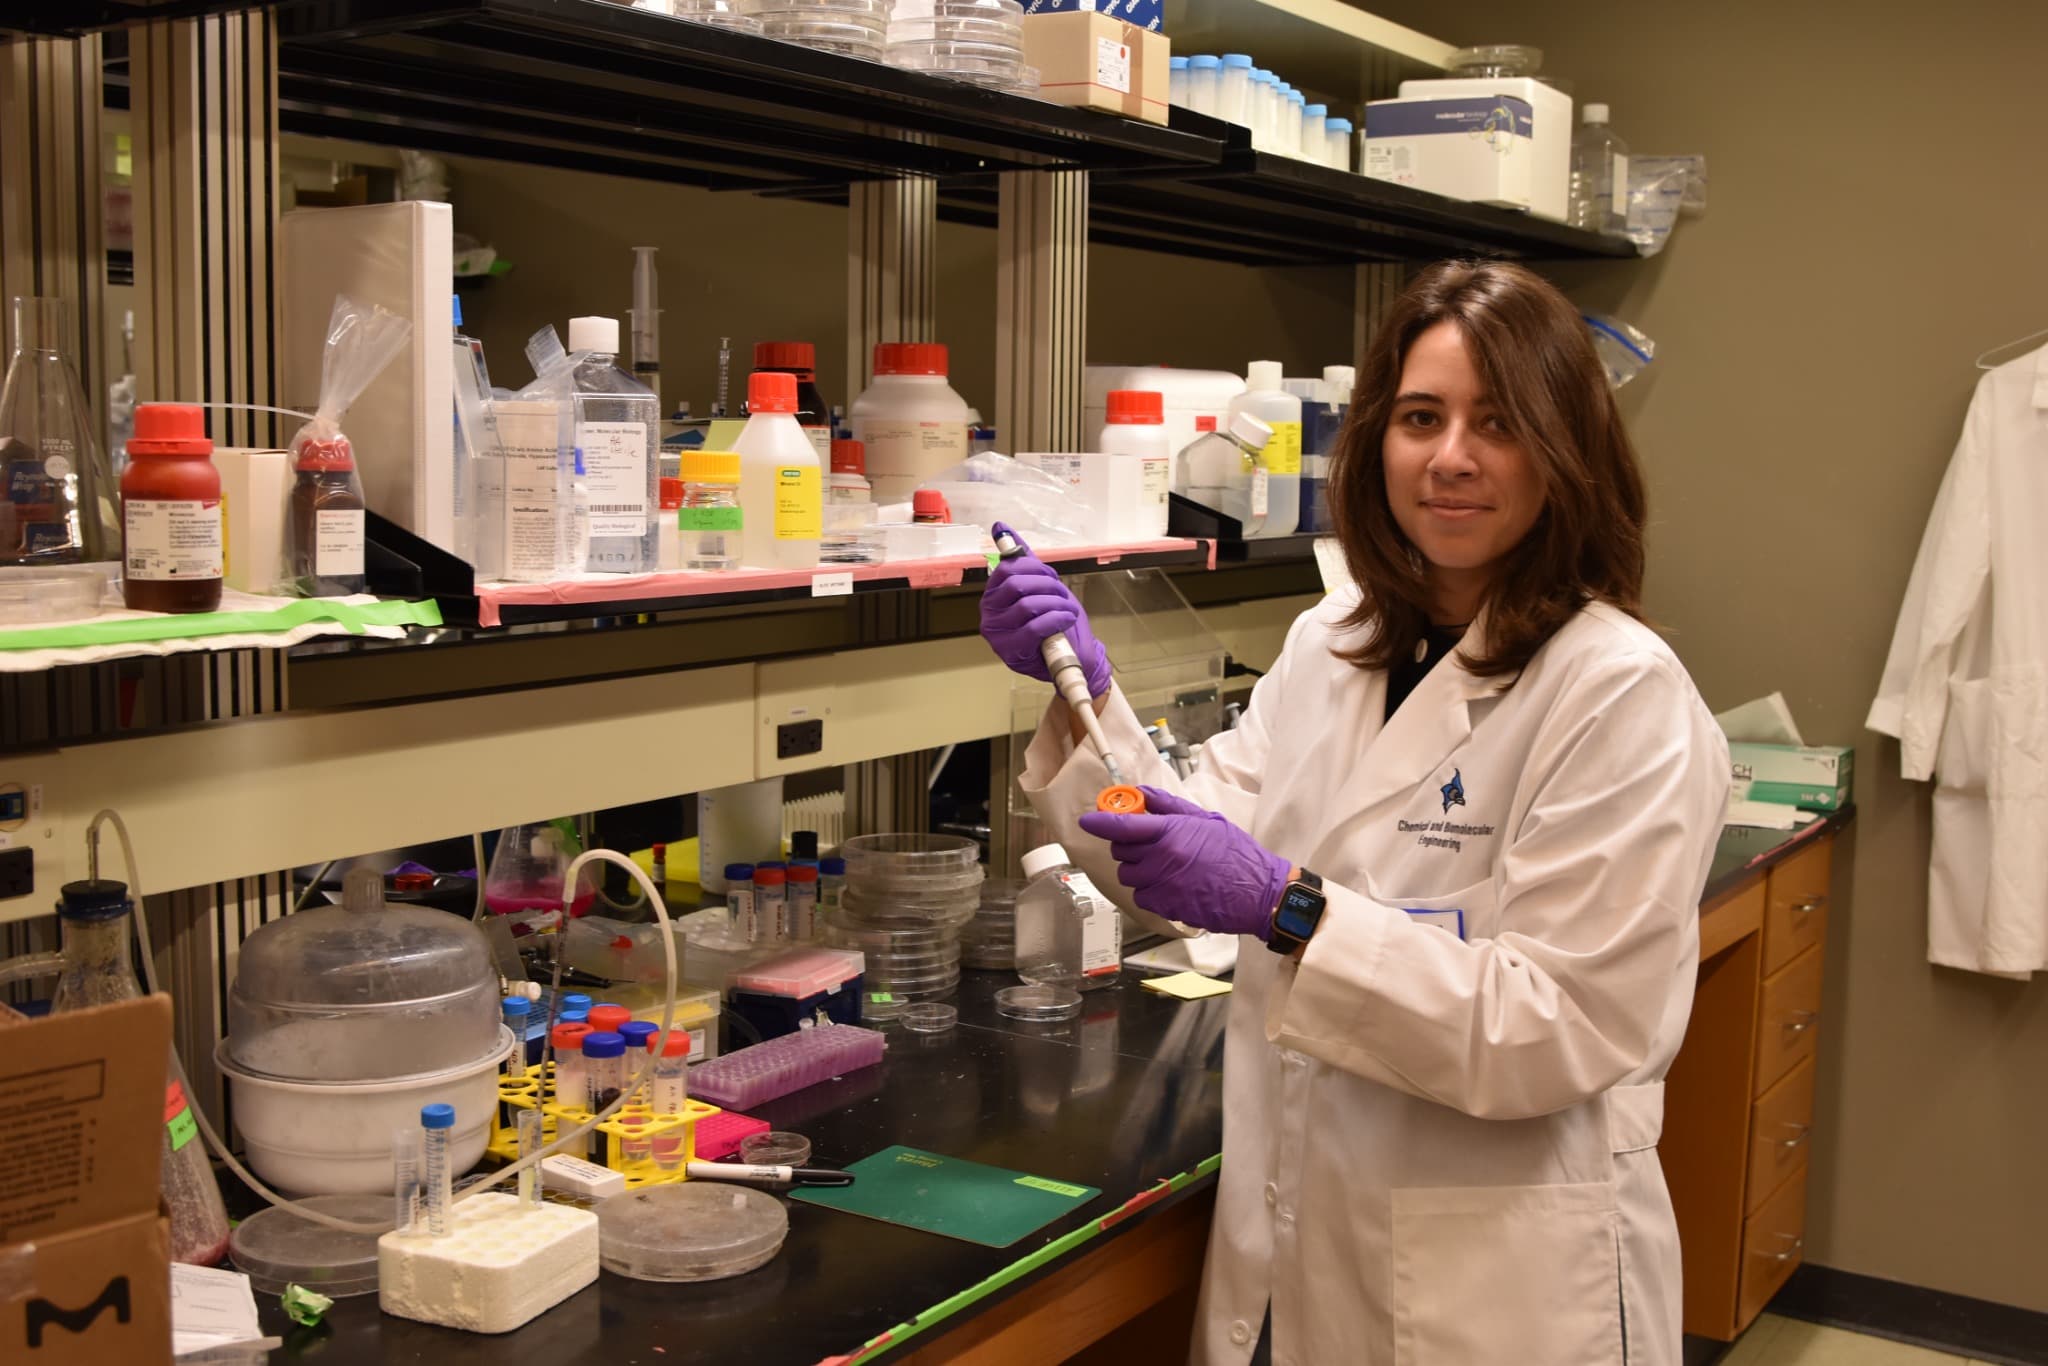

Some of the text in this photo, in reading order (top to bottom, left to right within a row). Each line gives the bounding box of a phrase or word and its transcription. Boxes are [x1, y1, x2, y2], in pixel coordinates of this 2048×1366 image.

[1431, 821, 1444, 832] and
[1443, 822, 1495, 835] Biomolecular
[1418, 834, 1461, 853] Engineering
